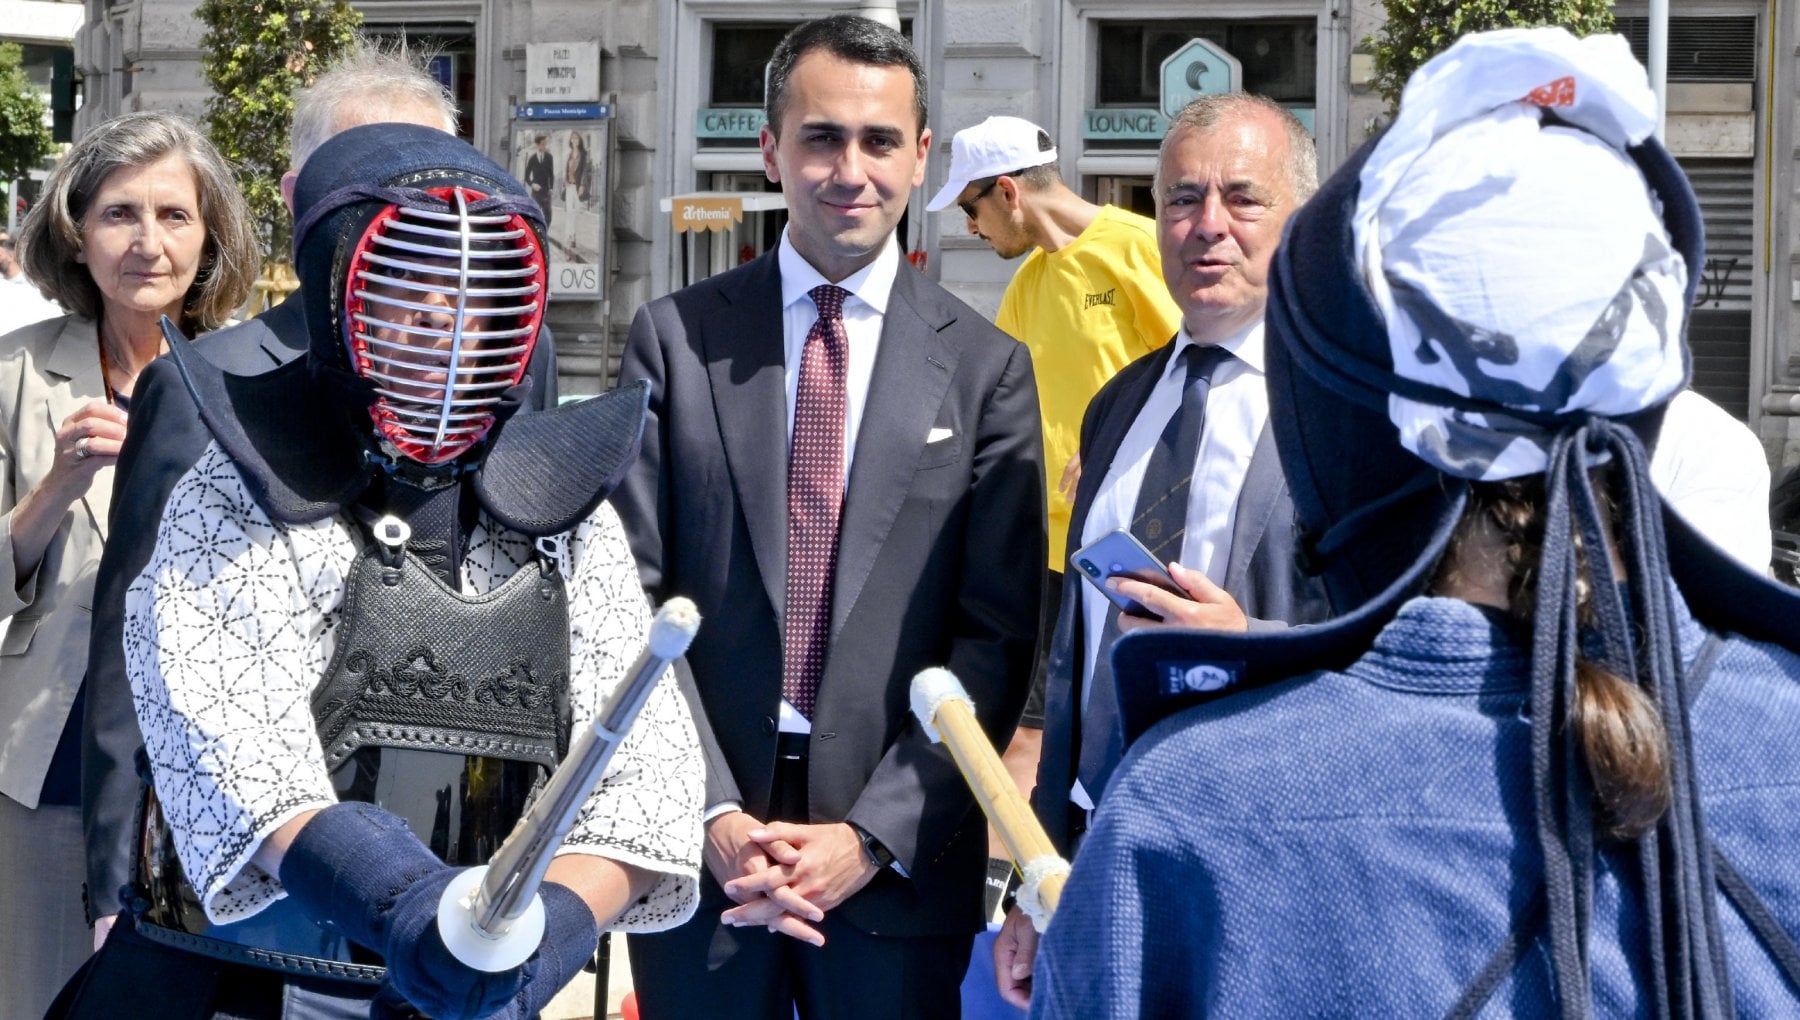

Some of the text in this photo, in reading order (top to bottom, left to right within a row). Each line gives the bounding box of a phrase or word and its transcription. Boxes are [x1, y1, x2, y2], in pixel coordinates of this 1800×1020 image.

[1088, 114, 1157, 133] LOUNGE
[560, 268, 596, 289] OVS
[1084, 288, 1116, 310] EVERLAST
